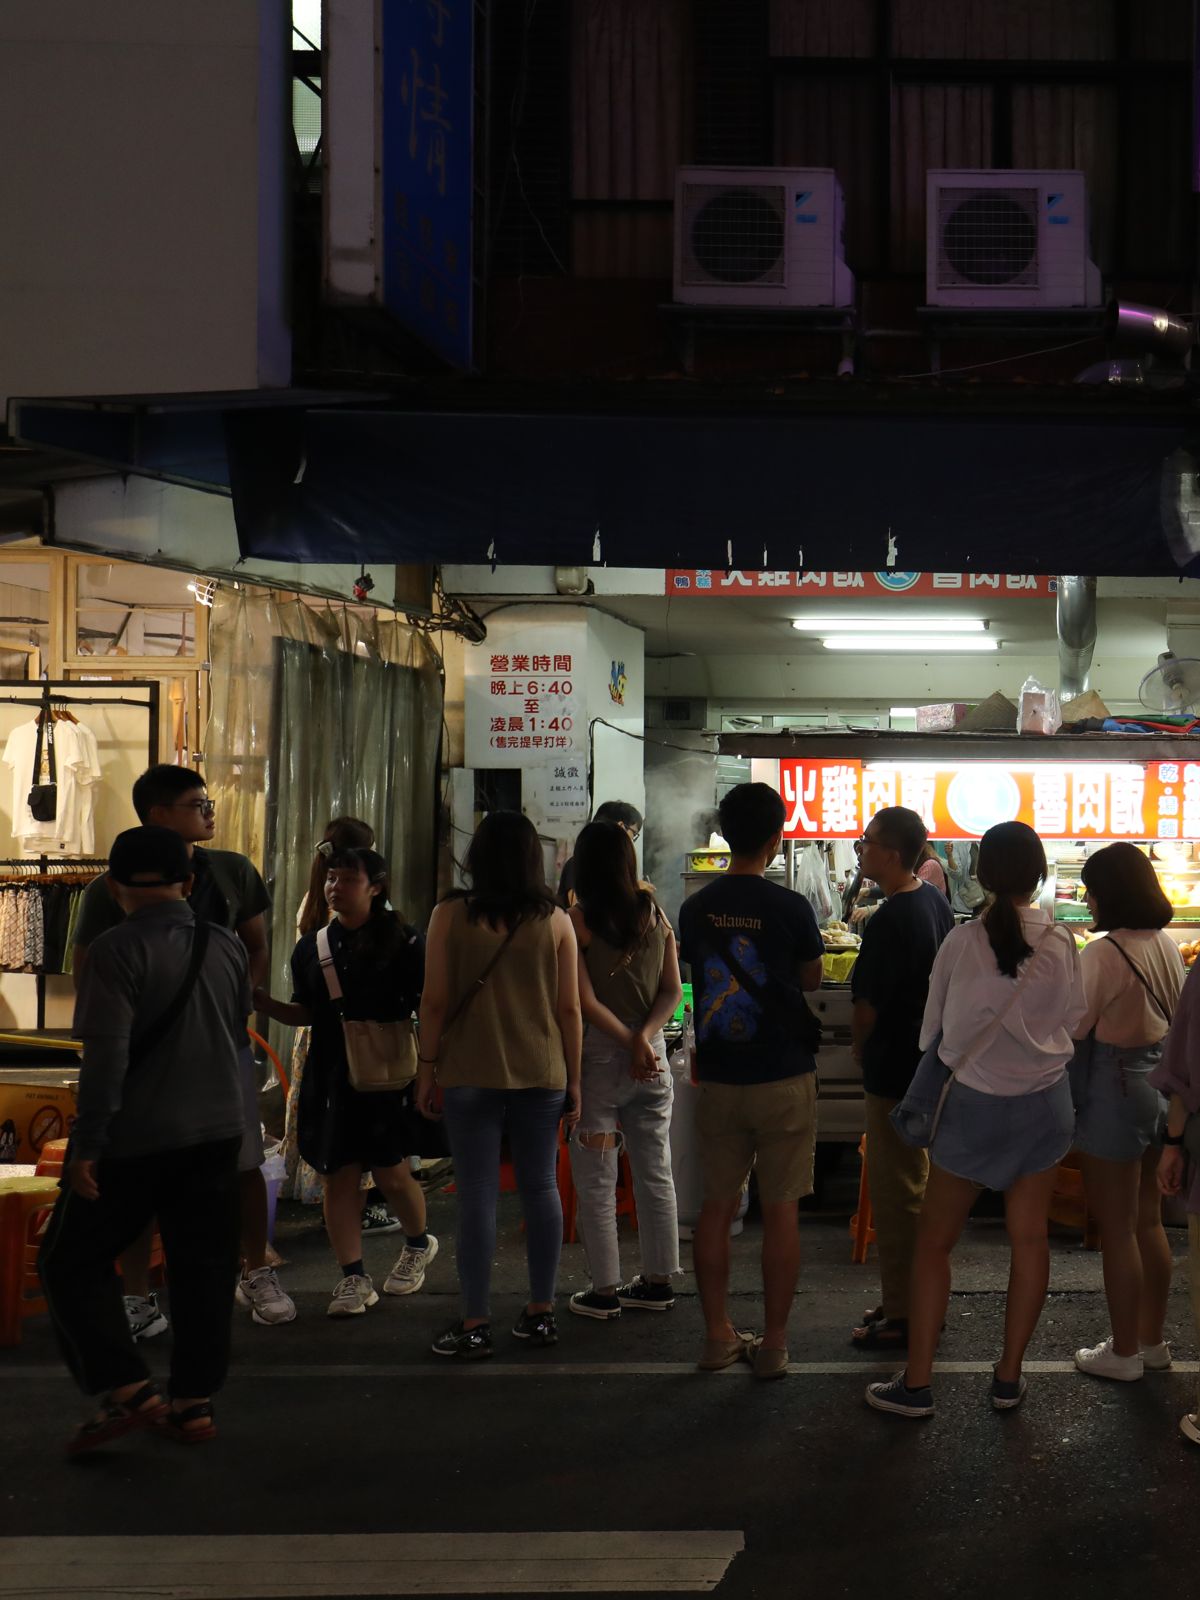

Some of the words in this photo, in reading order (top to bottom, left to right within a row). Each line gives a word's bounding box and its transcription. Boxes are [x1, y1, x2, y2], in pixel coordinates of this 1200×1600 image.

[490, 654, 572, 672] 營業時間
[490, 680, 573, 696] 晚上6:40
[524, 698, 540, 714] 至
[490, 717, 573, 732] 凌晨1:40
